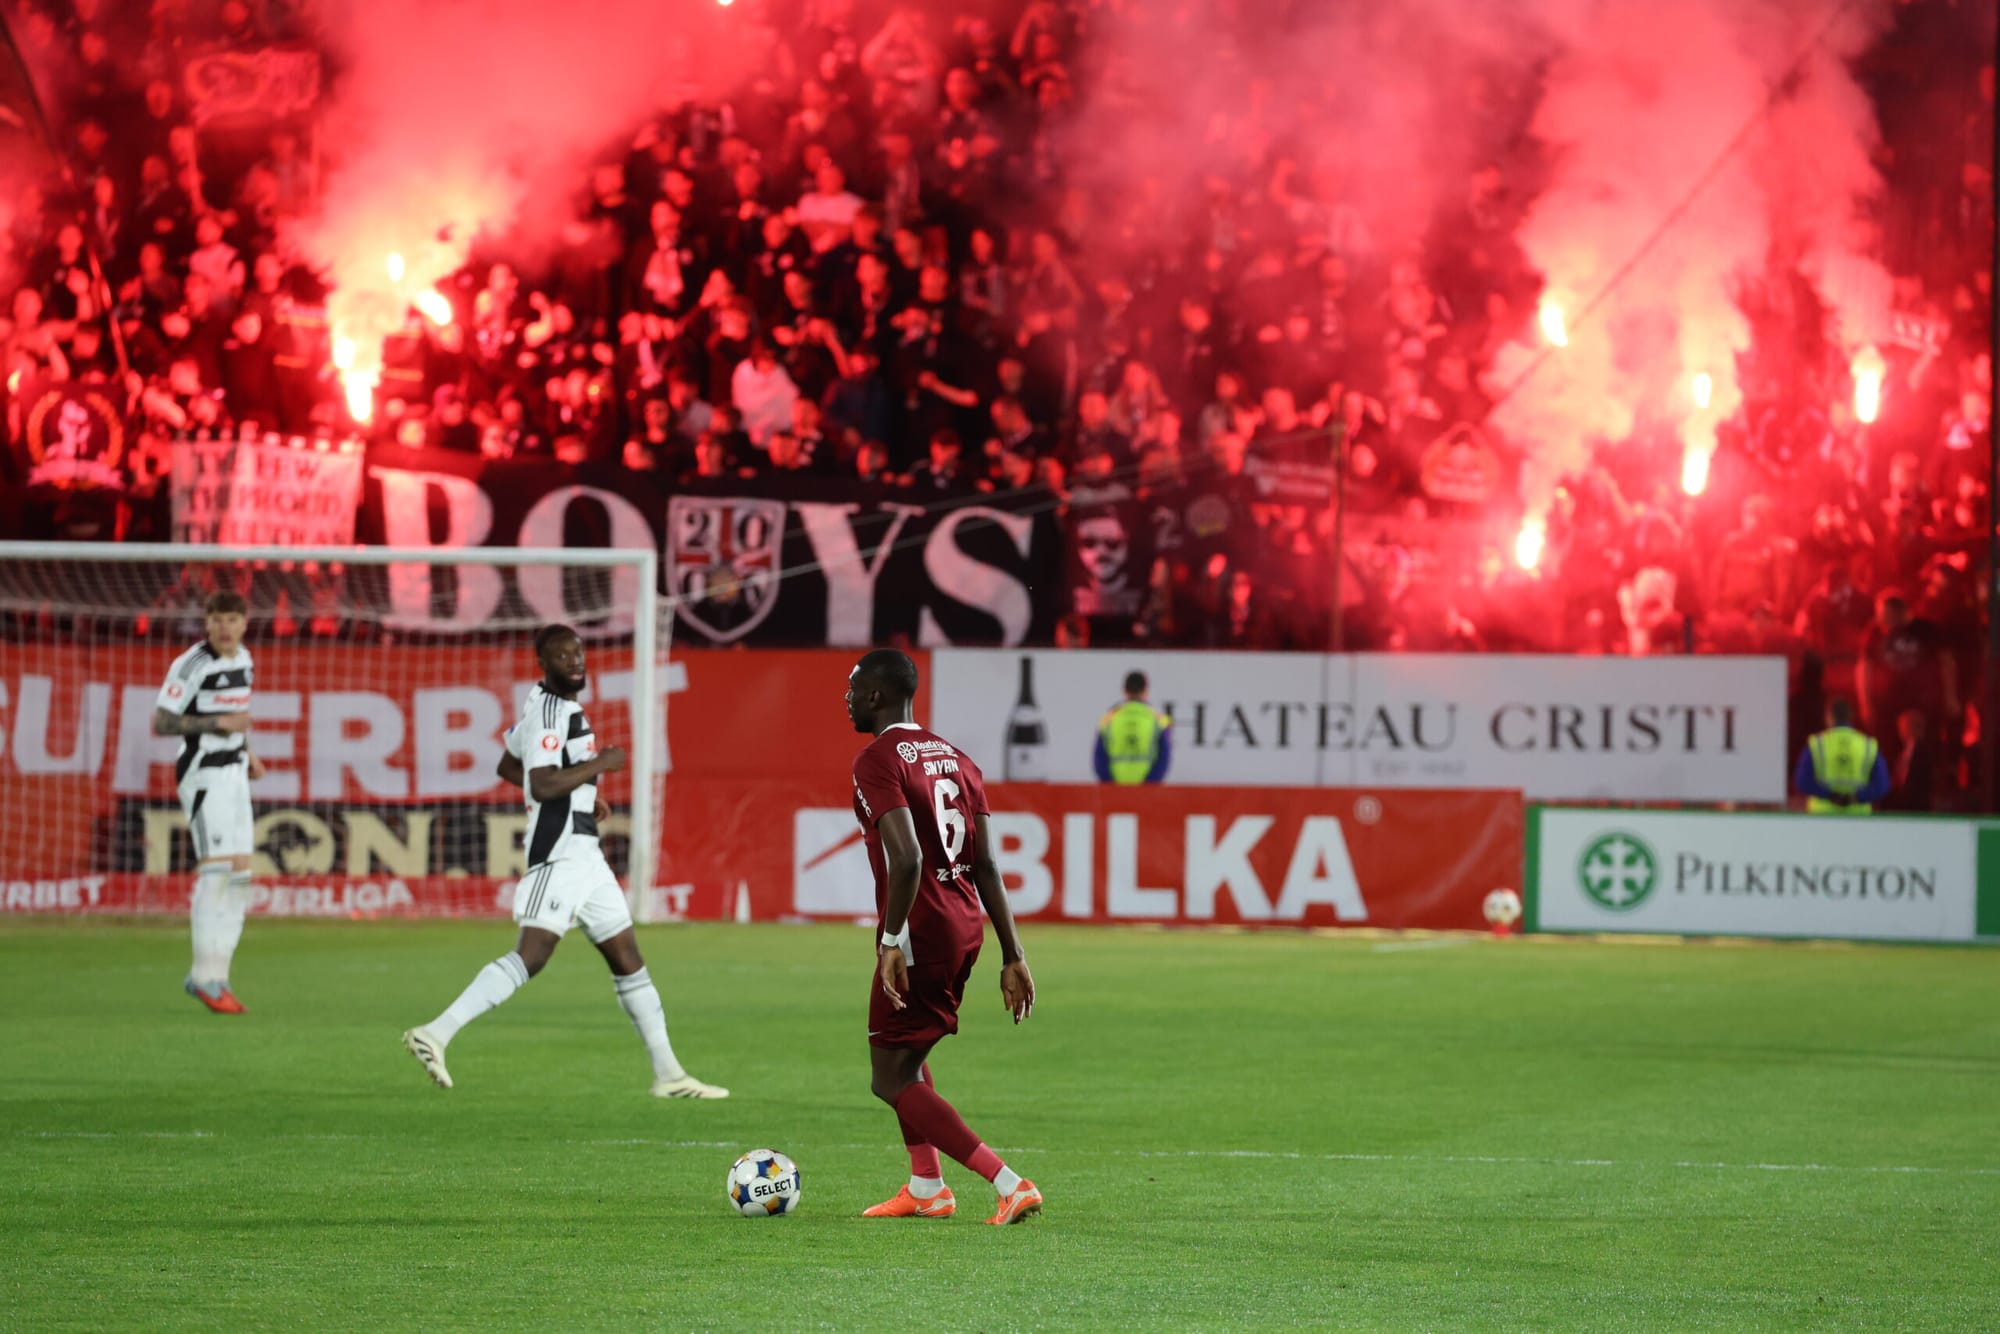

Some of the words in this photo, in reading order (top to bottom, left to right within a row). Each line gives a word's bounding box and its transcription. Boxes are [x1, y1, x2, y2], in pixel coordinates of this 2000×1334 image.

[1161, 701, 1459, 751] HATEAU
[1489, 702, 1738, 752] CRISTI
[934, 778, 966, 863] 6
[978, 812, 1367, 921] BILKA
[1676, 852, 1936, 901] PILKINGTON
[754, 1179, 791, 1197] SELECT
